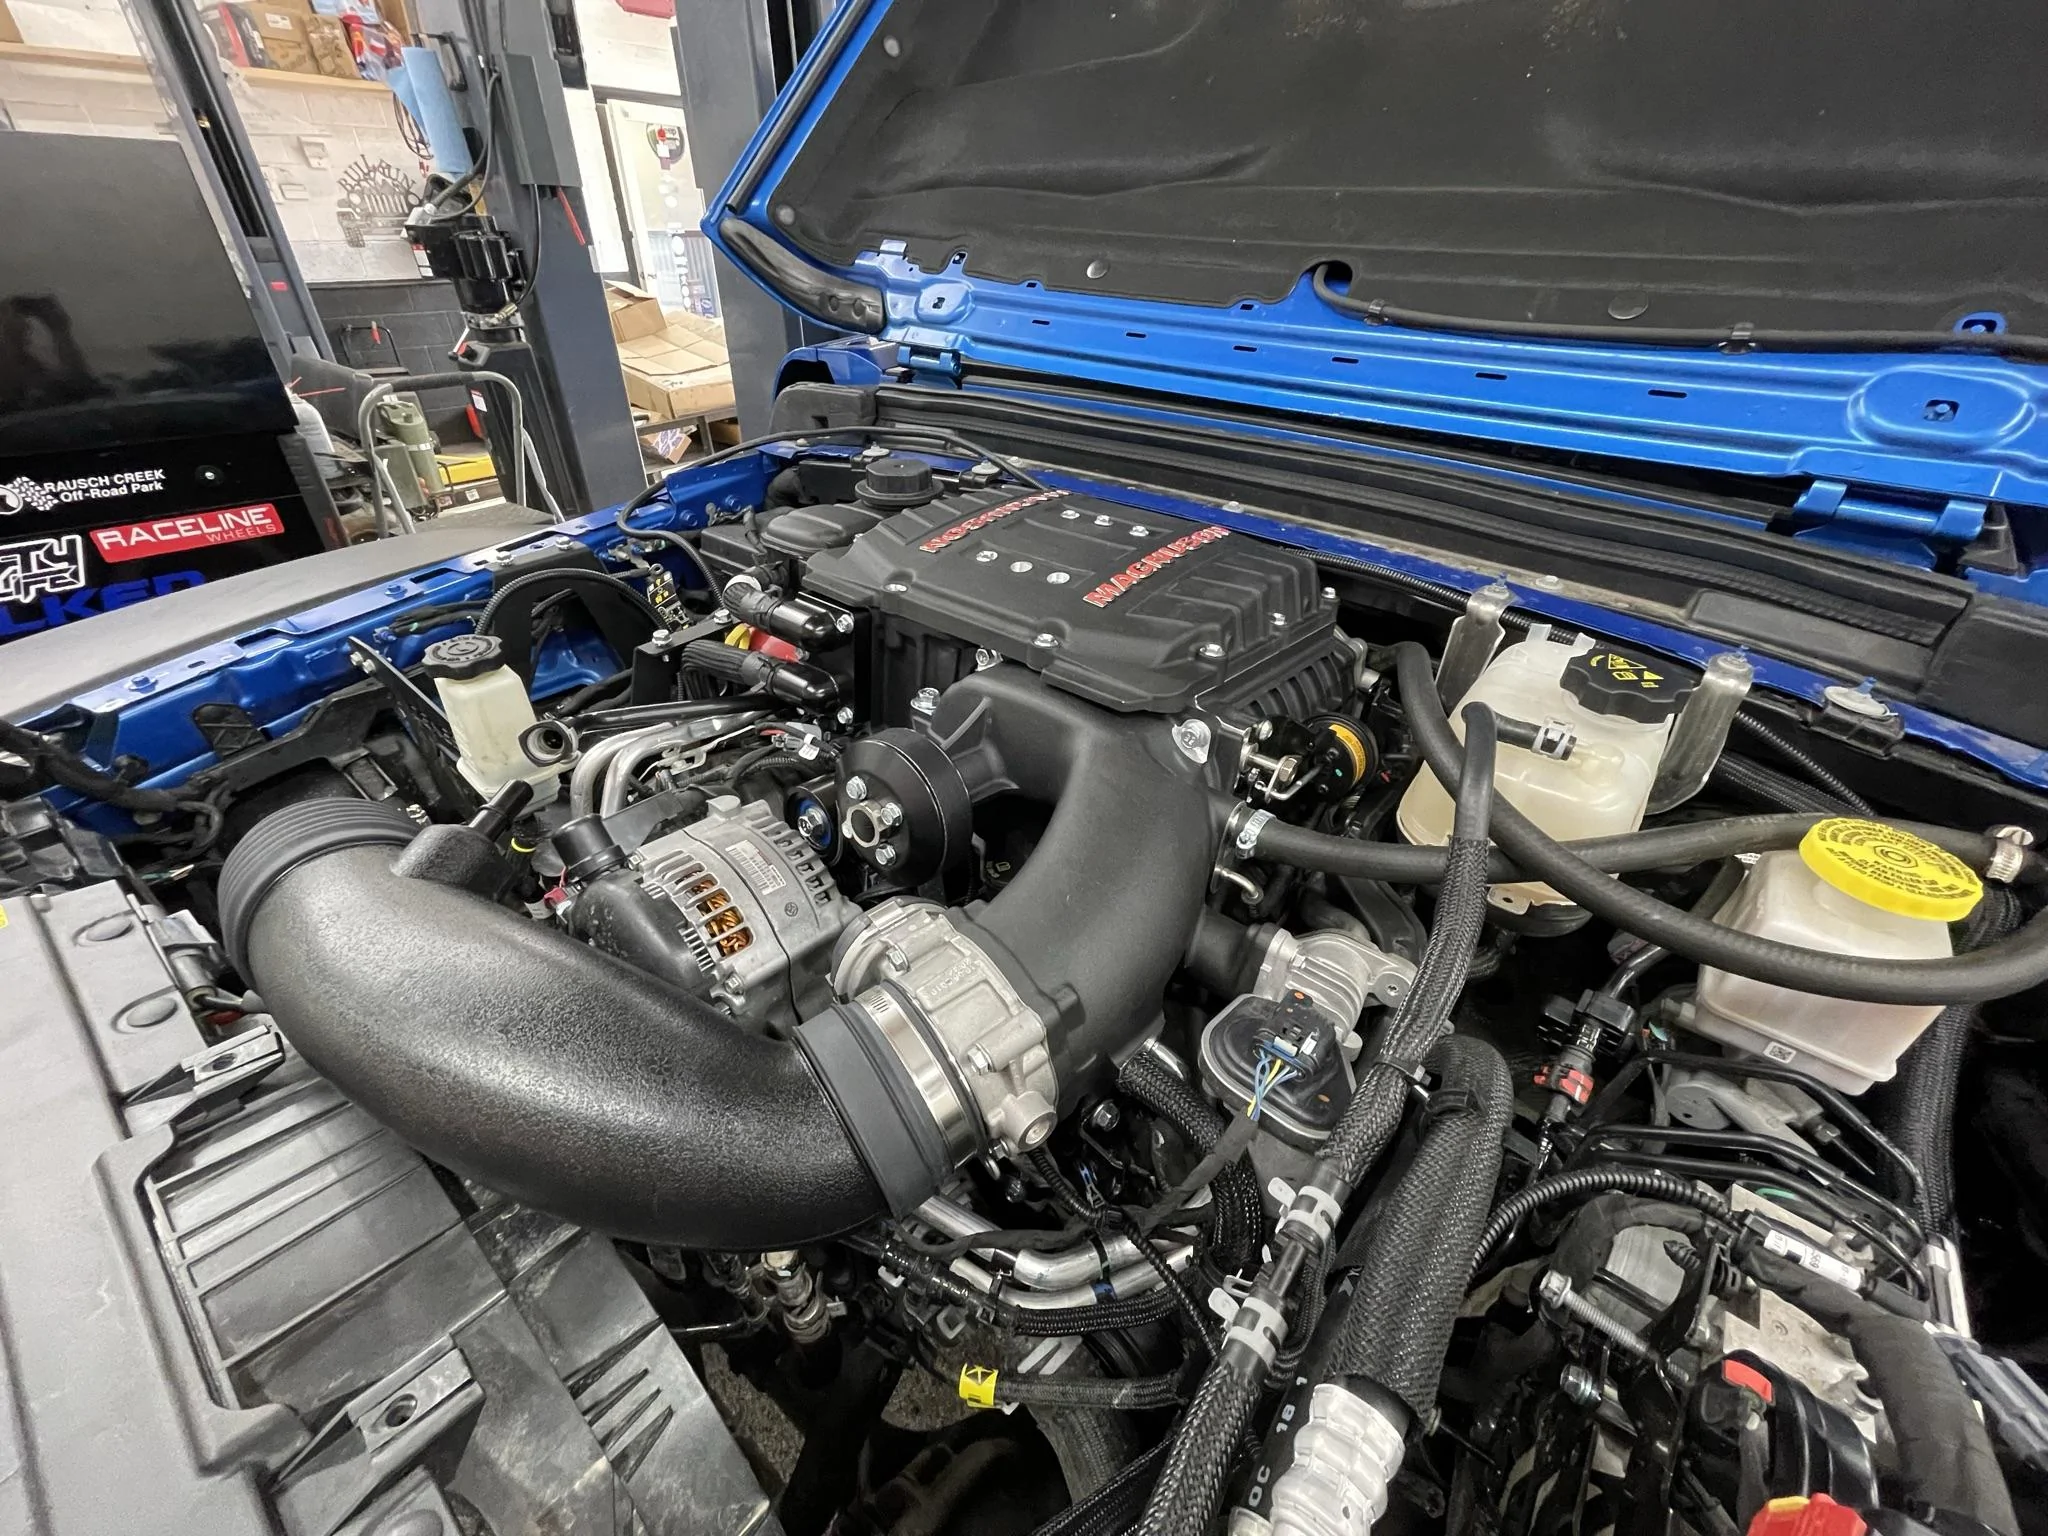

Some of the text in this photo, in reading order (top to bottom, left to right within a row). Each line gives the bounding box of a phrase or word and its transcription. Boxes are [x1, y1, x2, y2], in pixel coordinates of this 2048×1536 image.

[336, 153, 372, 193] BULL
[43, 468, 166, 493] RAUSCH CREEK
[59, 481, 164, 503] Off-Road Park
[97, 507, 272, 550] RACELINE
[206, 523, 277, 543] WHEELS
[1083, 525, 1231, 608] MAGNUSON
